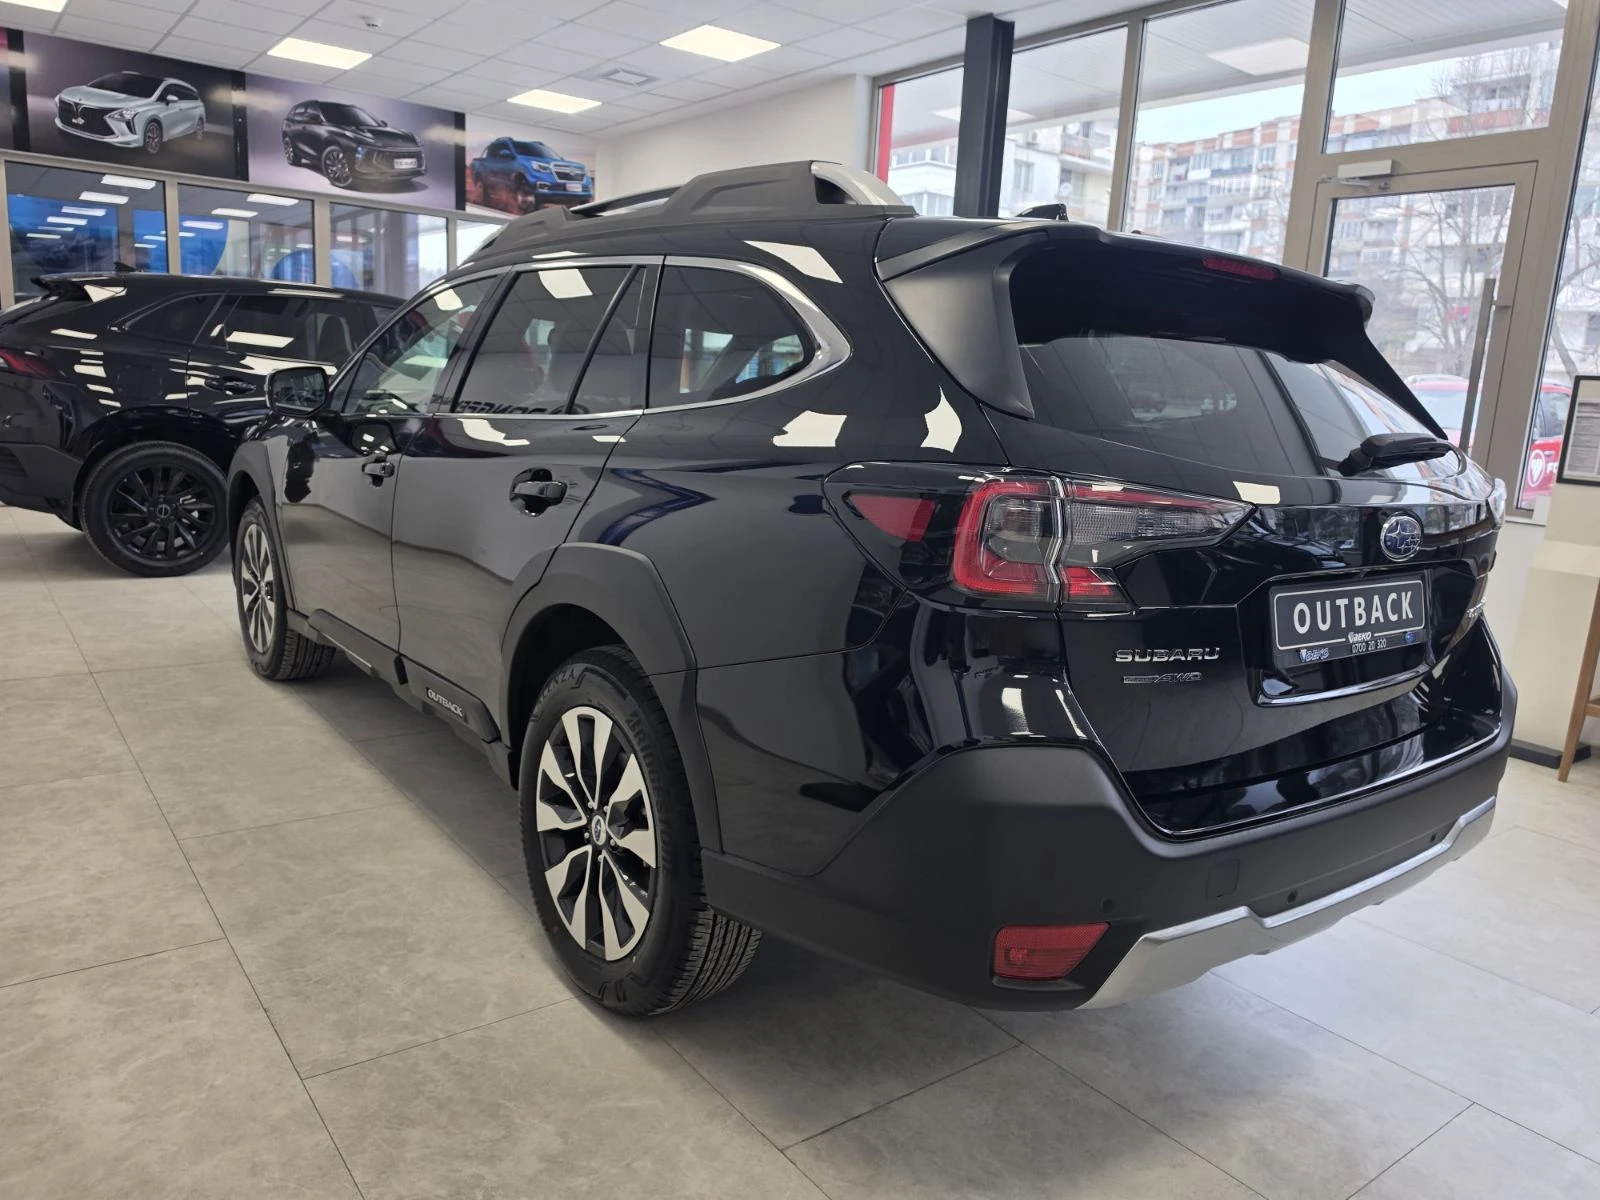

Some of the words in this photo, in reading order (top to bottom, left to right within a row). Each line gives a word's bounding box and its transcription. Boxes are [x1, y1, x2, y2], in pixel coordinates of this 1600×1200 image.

[1293, 591, 1415, 634] OUTBACK
[1115, 647, 1221, 662] SUBARU
[1352, 643, 1366, 654] 0700
[427, 689, 463, 717] OUTBACK
